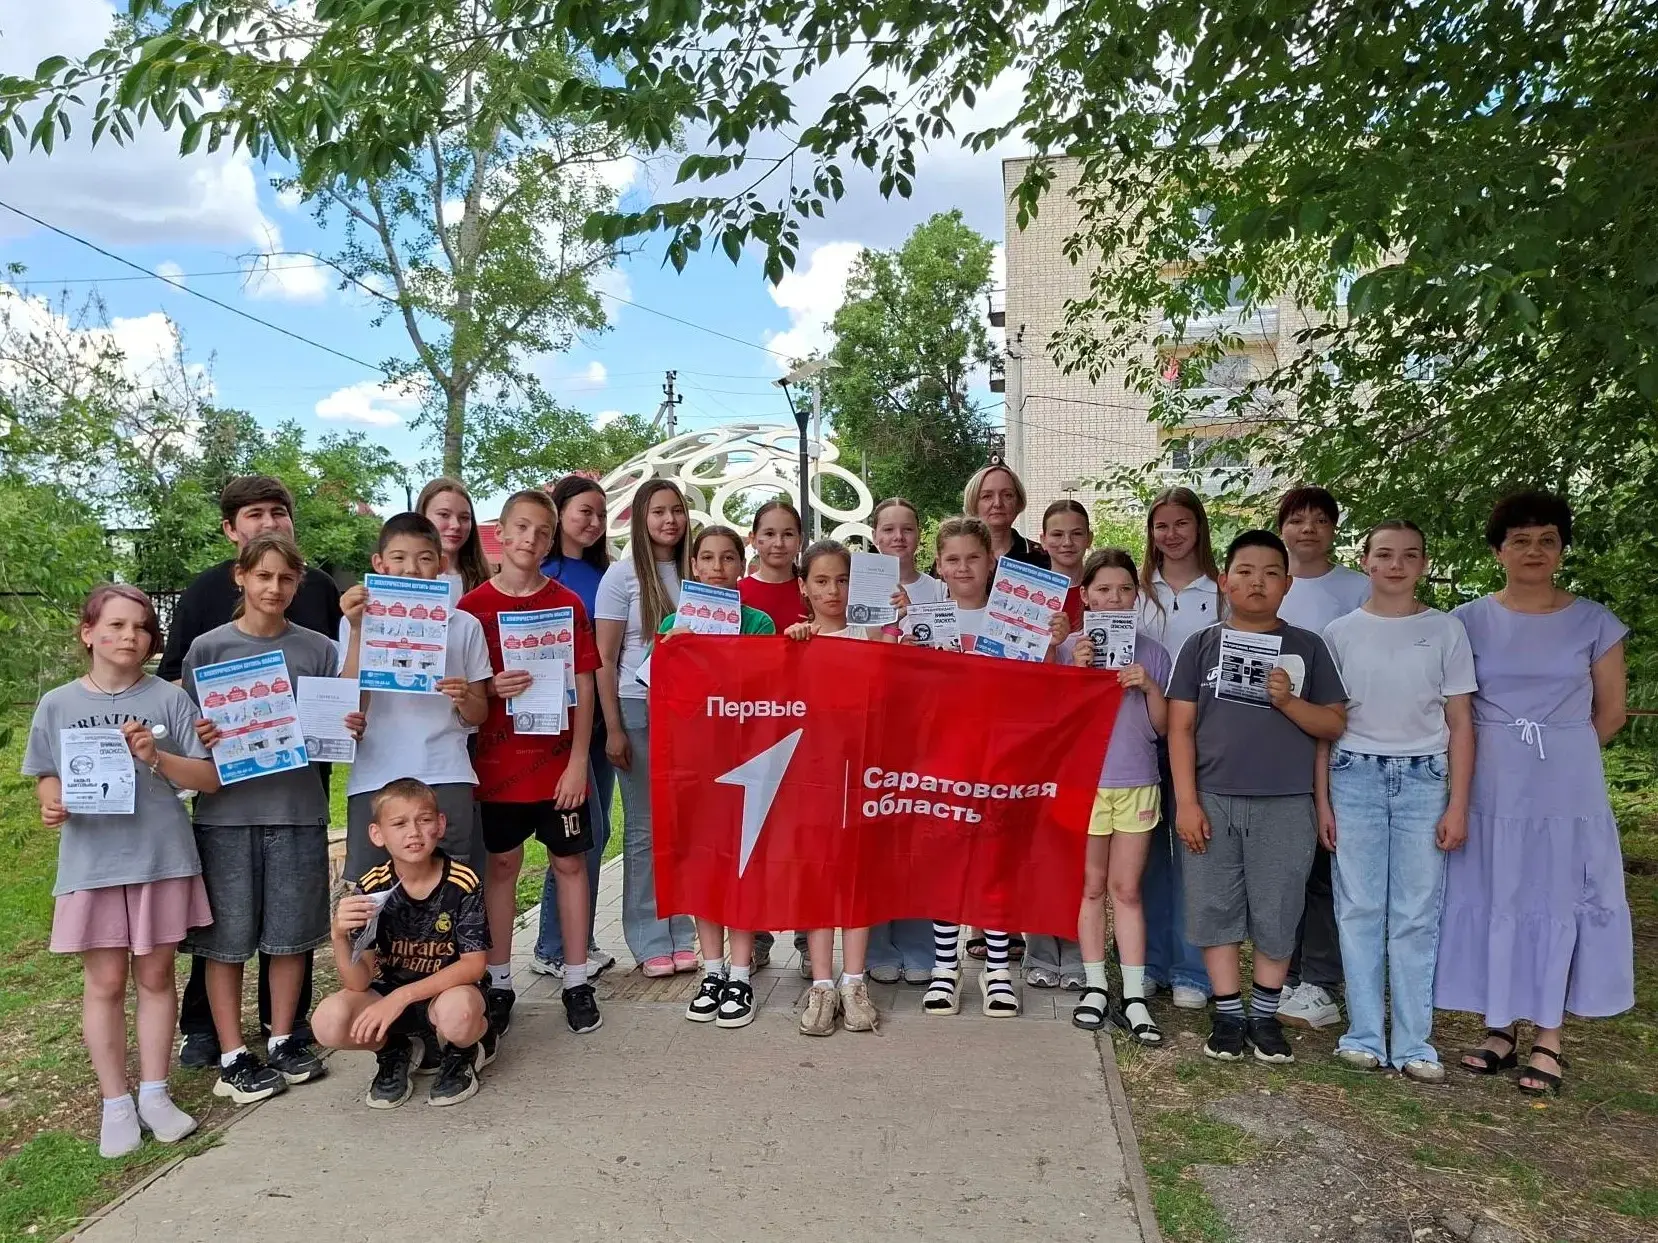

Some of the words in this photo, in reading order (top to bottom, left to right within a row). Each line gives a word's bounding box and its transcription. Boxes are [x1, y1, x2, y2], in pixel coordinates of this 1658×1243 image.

[706, 696, 807, 724] Первые
[862, 766, 1058, 800] Саратовская
[862, 791, 982, 824] область
[561, 812, 581, 838] 10
[401, 957, 442, 973] BETTER
